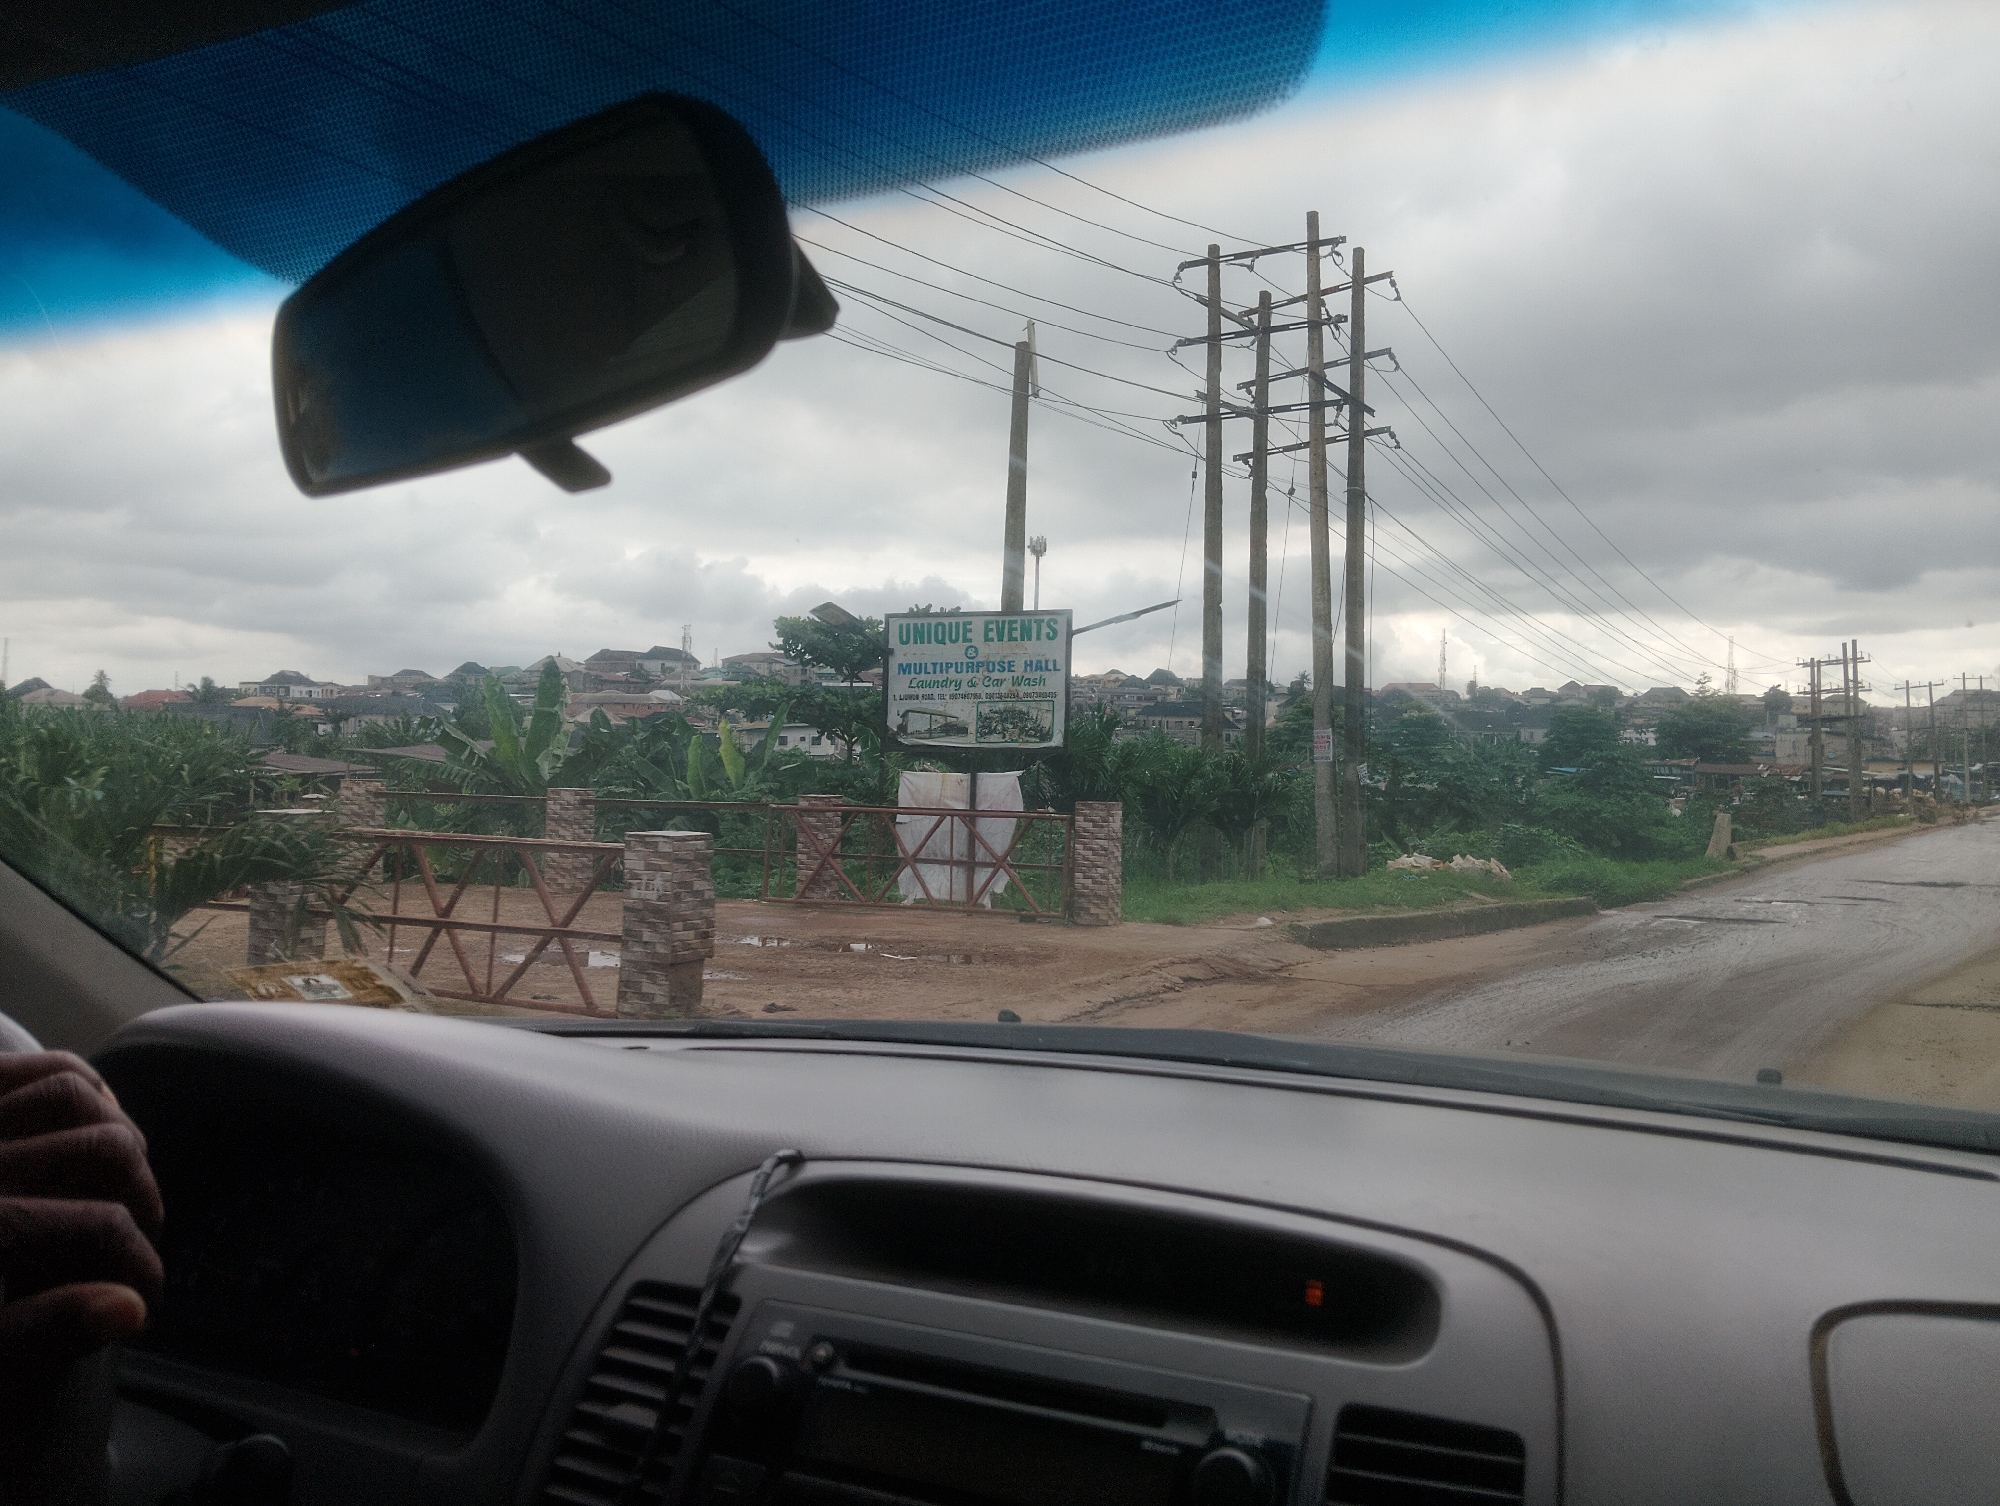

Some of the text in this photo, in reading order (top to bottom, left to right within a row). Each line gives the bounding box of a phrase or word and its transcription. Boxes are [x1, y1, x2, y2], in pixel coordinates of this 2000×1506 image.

[899, 618, 1058, 645] UNIQUE EVENTS
[965, 646, 978, 659] &
[898, 659, 1061, 675] MULTIPURPOSE HALL
[908, 675, 1046, 691] Laundry & Car Wash
